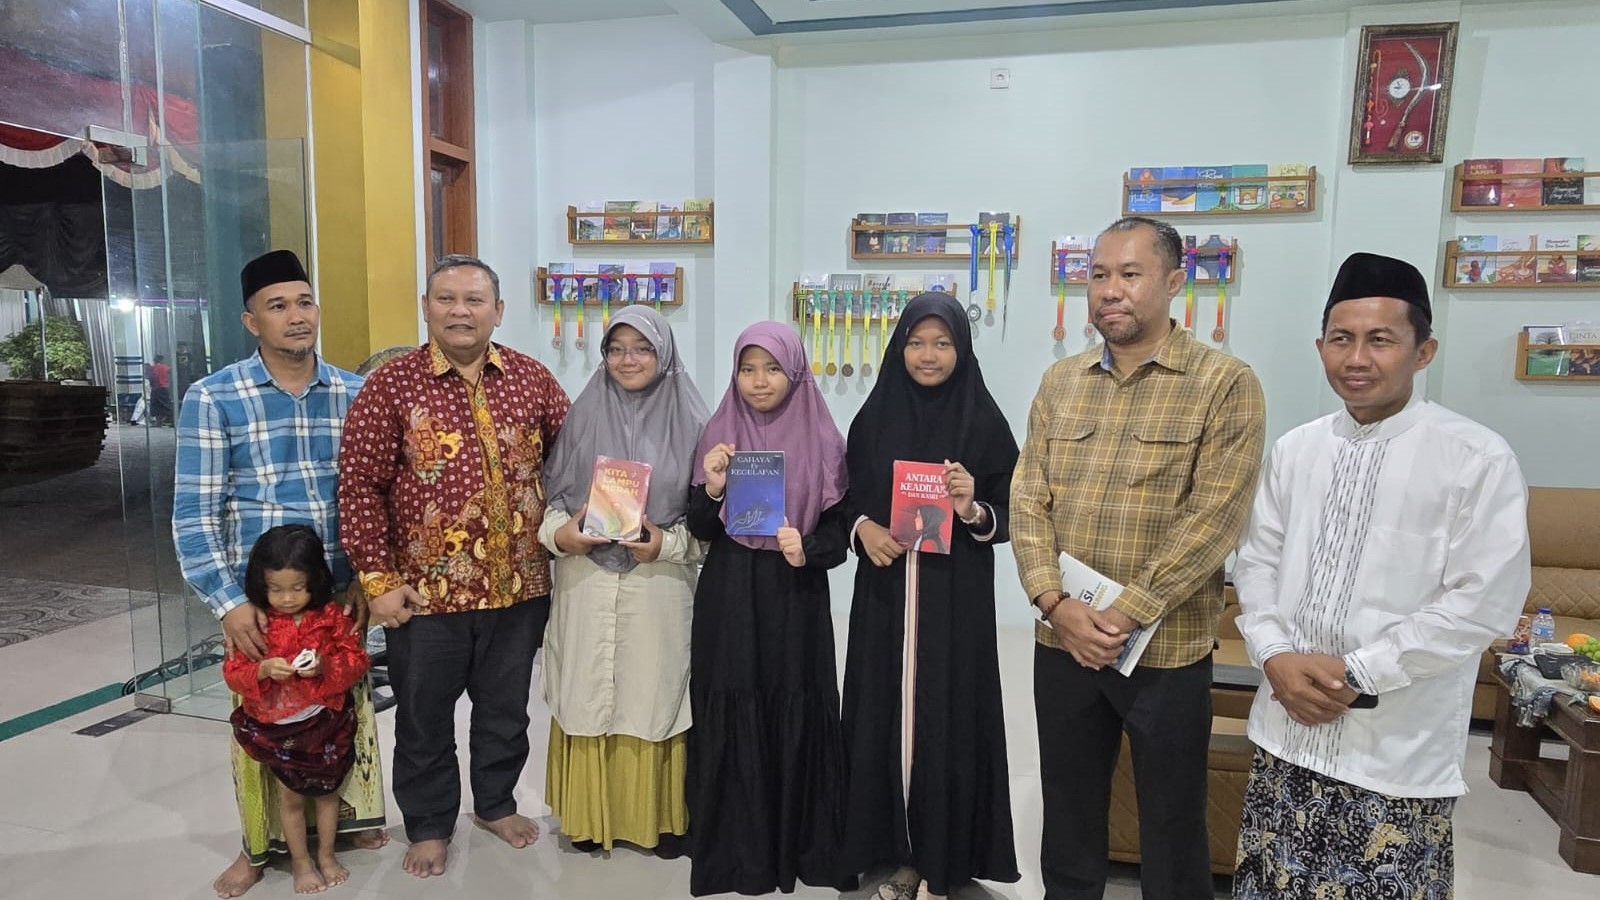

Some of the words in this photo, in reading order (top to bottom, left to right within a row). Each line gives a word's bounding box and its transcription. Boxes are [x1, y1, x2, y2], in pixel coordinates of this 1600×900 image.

[604, 467, 628, 478] KITA
[731, 468, 780, 476] KEGELAPAN
[905, 472, 943, 484] ANTARA
[603, 475, 640, 488] LAMPU
[601, 483, 640, 497] MERAH
[1083, 590, 1095, 605] SI
